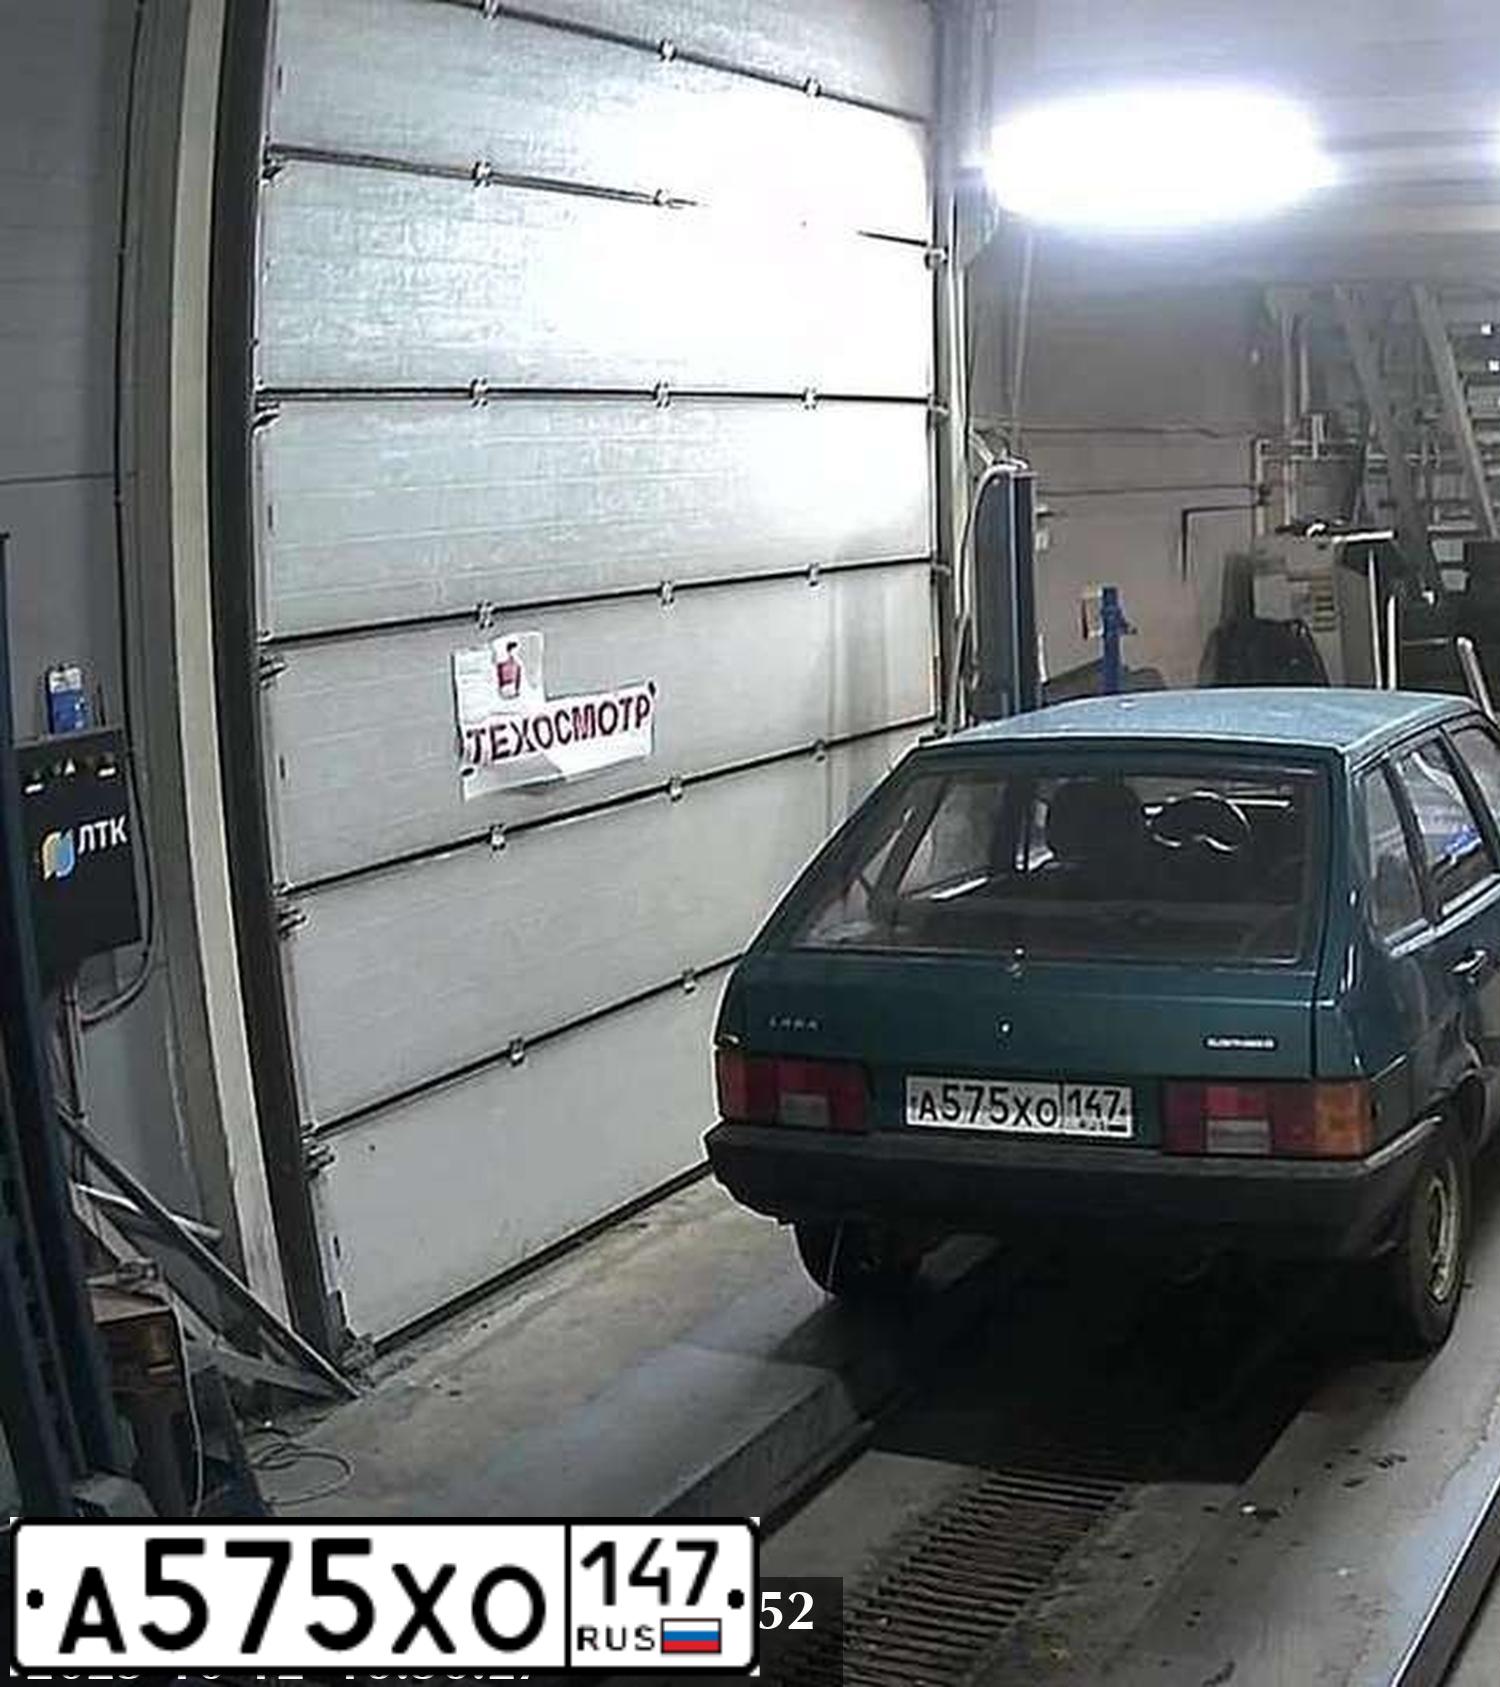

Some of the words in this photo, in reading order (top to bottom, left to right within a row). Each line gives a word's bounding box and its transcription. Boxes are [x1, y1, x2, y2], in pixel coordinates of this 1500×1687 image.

[466, 695, 651, 764] ТЕХОСМОТР
[77, 815, 128, 854] ЛТК
[1068, 1089, 1121, 1120] 147
